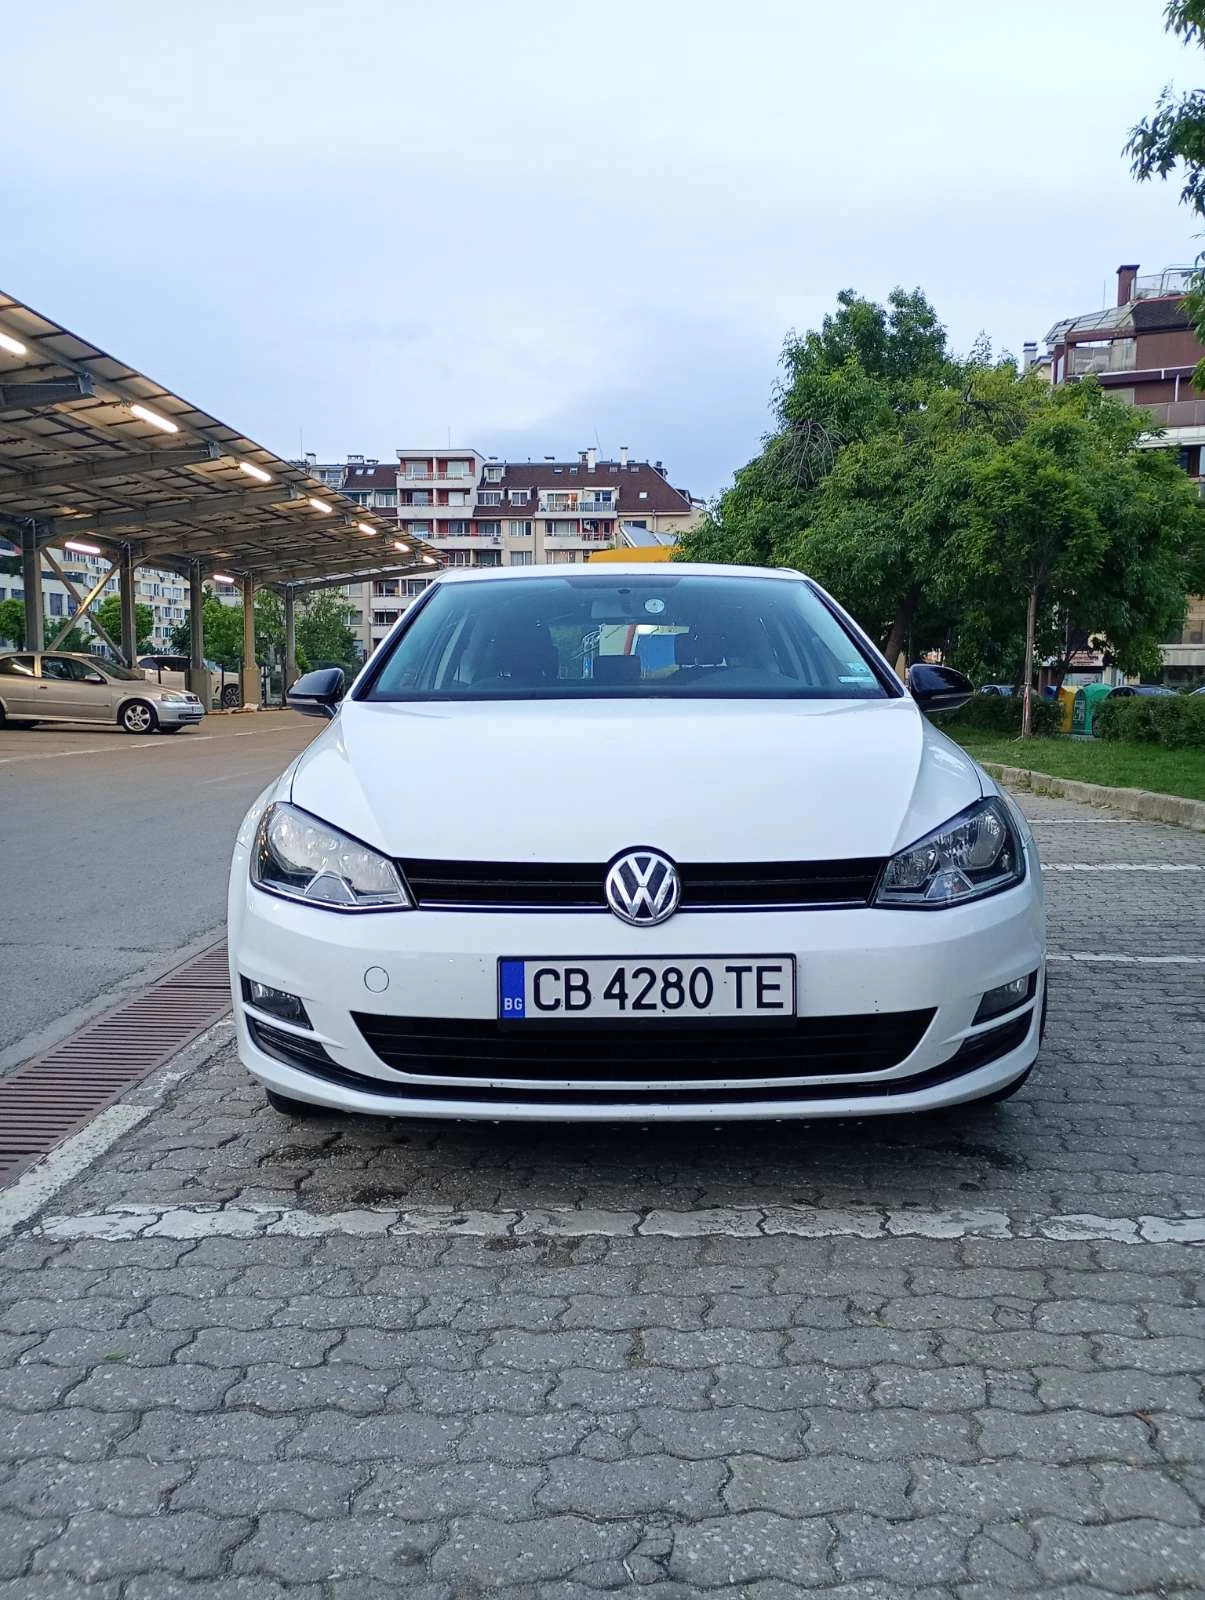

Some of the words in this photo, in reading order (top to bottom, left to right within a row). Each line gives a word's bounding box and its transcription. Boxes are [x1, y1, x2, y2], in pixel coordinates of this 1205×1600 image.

[609, 854, 677, 921] VW
[504, 997, 523, 1011] BG
[533, 967, 592, 1012] CB
[603, 966, 714, 1011] 4280
[725, 965, 784, 1010] TE
